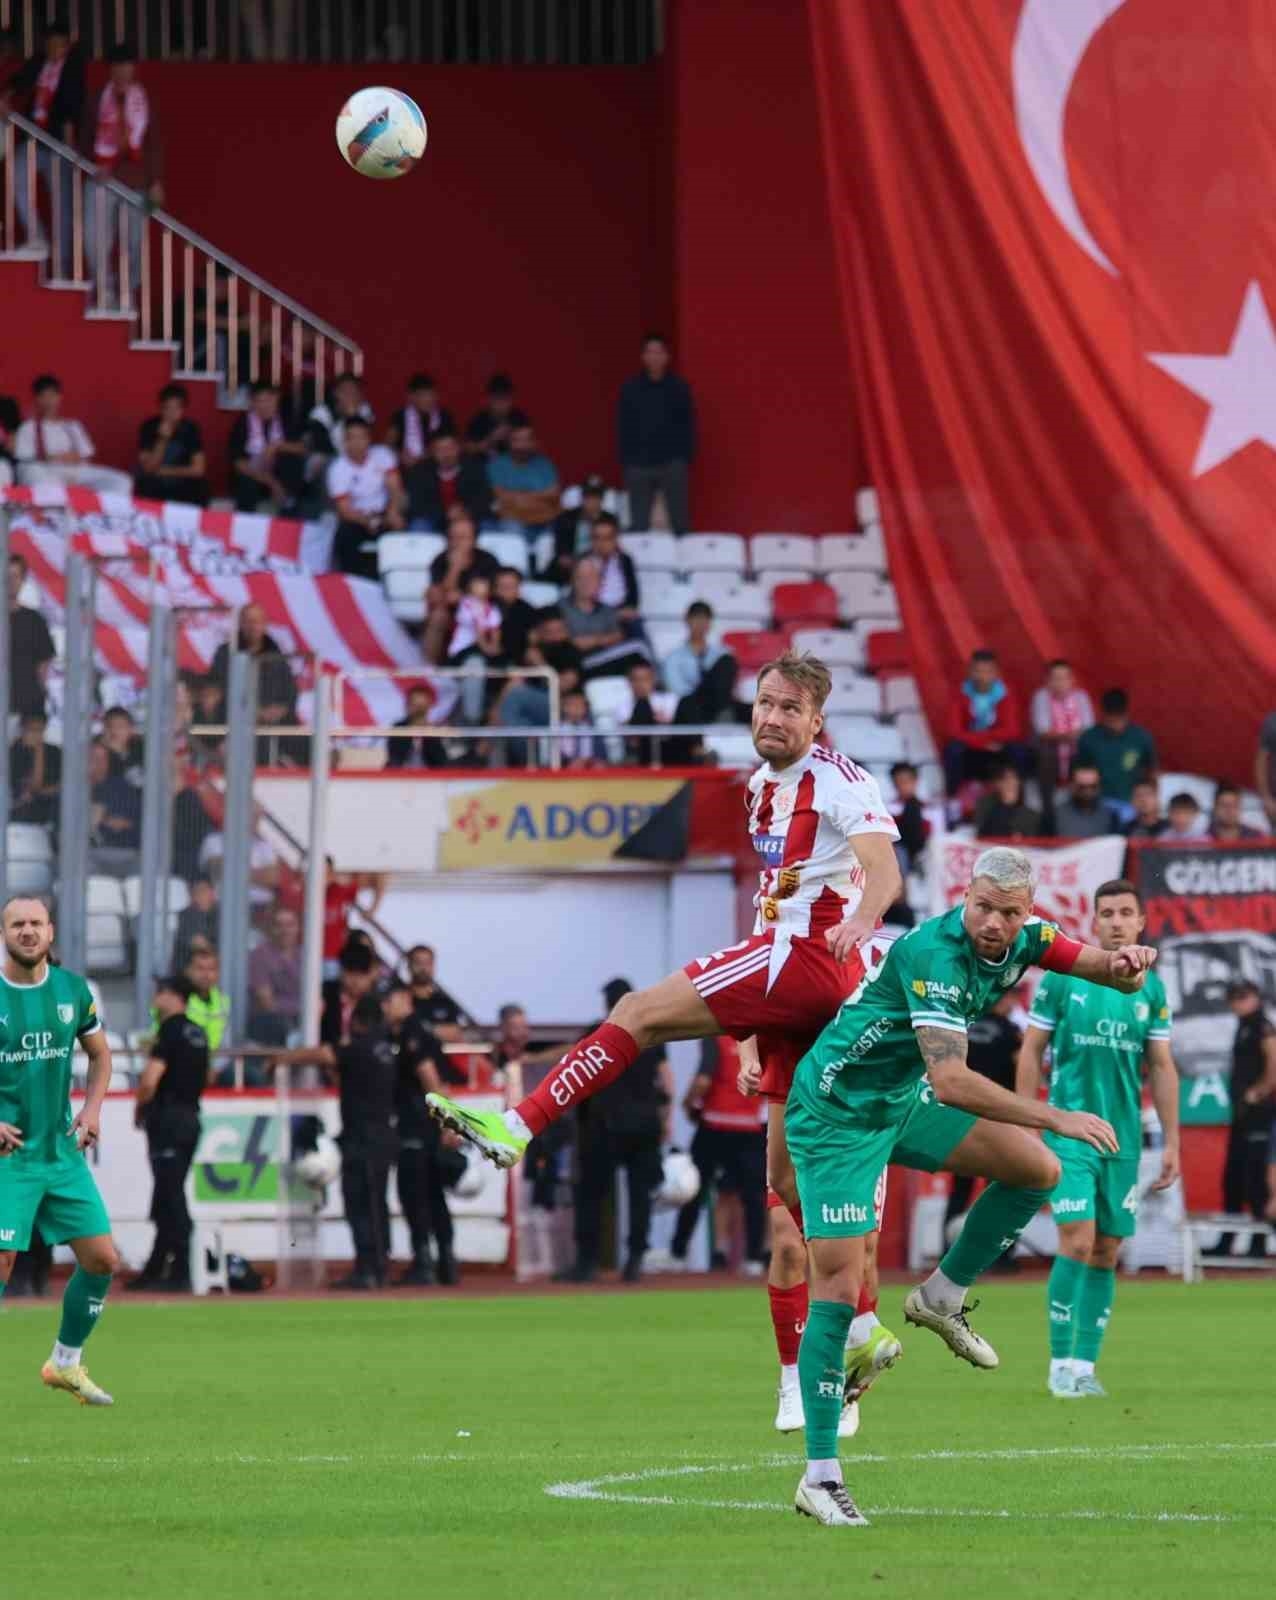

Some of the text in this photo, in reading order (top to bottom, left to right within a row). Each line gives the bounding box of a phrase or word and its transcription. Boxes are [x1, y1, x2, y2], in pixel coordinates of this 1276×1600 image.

[505, 801, 661, 841] ADOP
[1096, 1019, 1129, 1038] CIP
[21, 1031, 53, 1050] CIP
